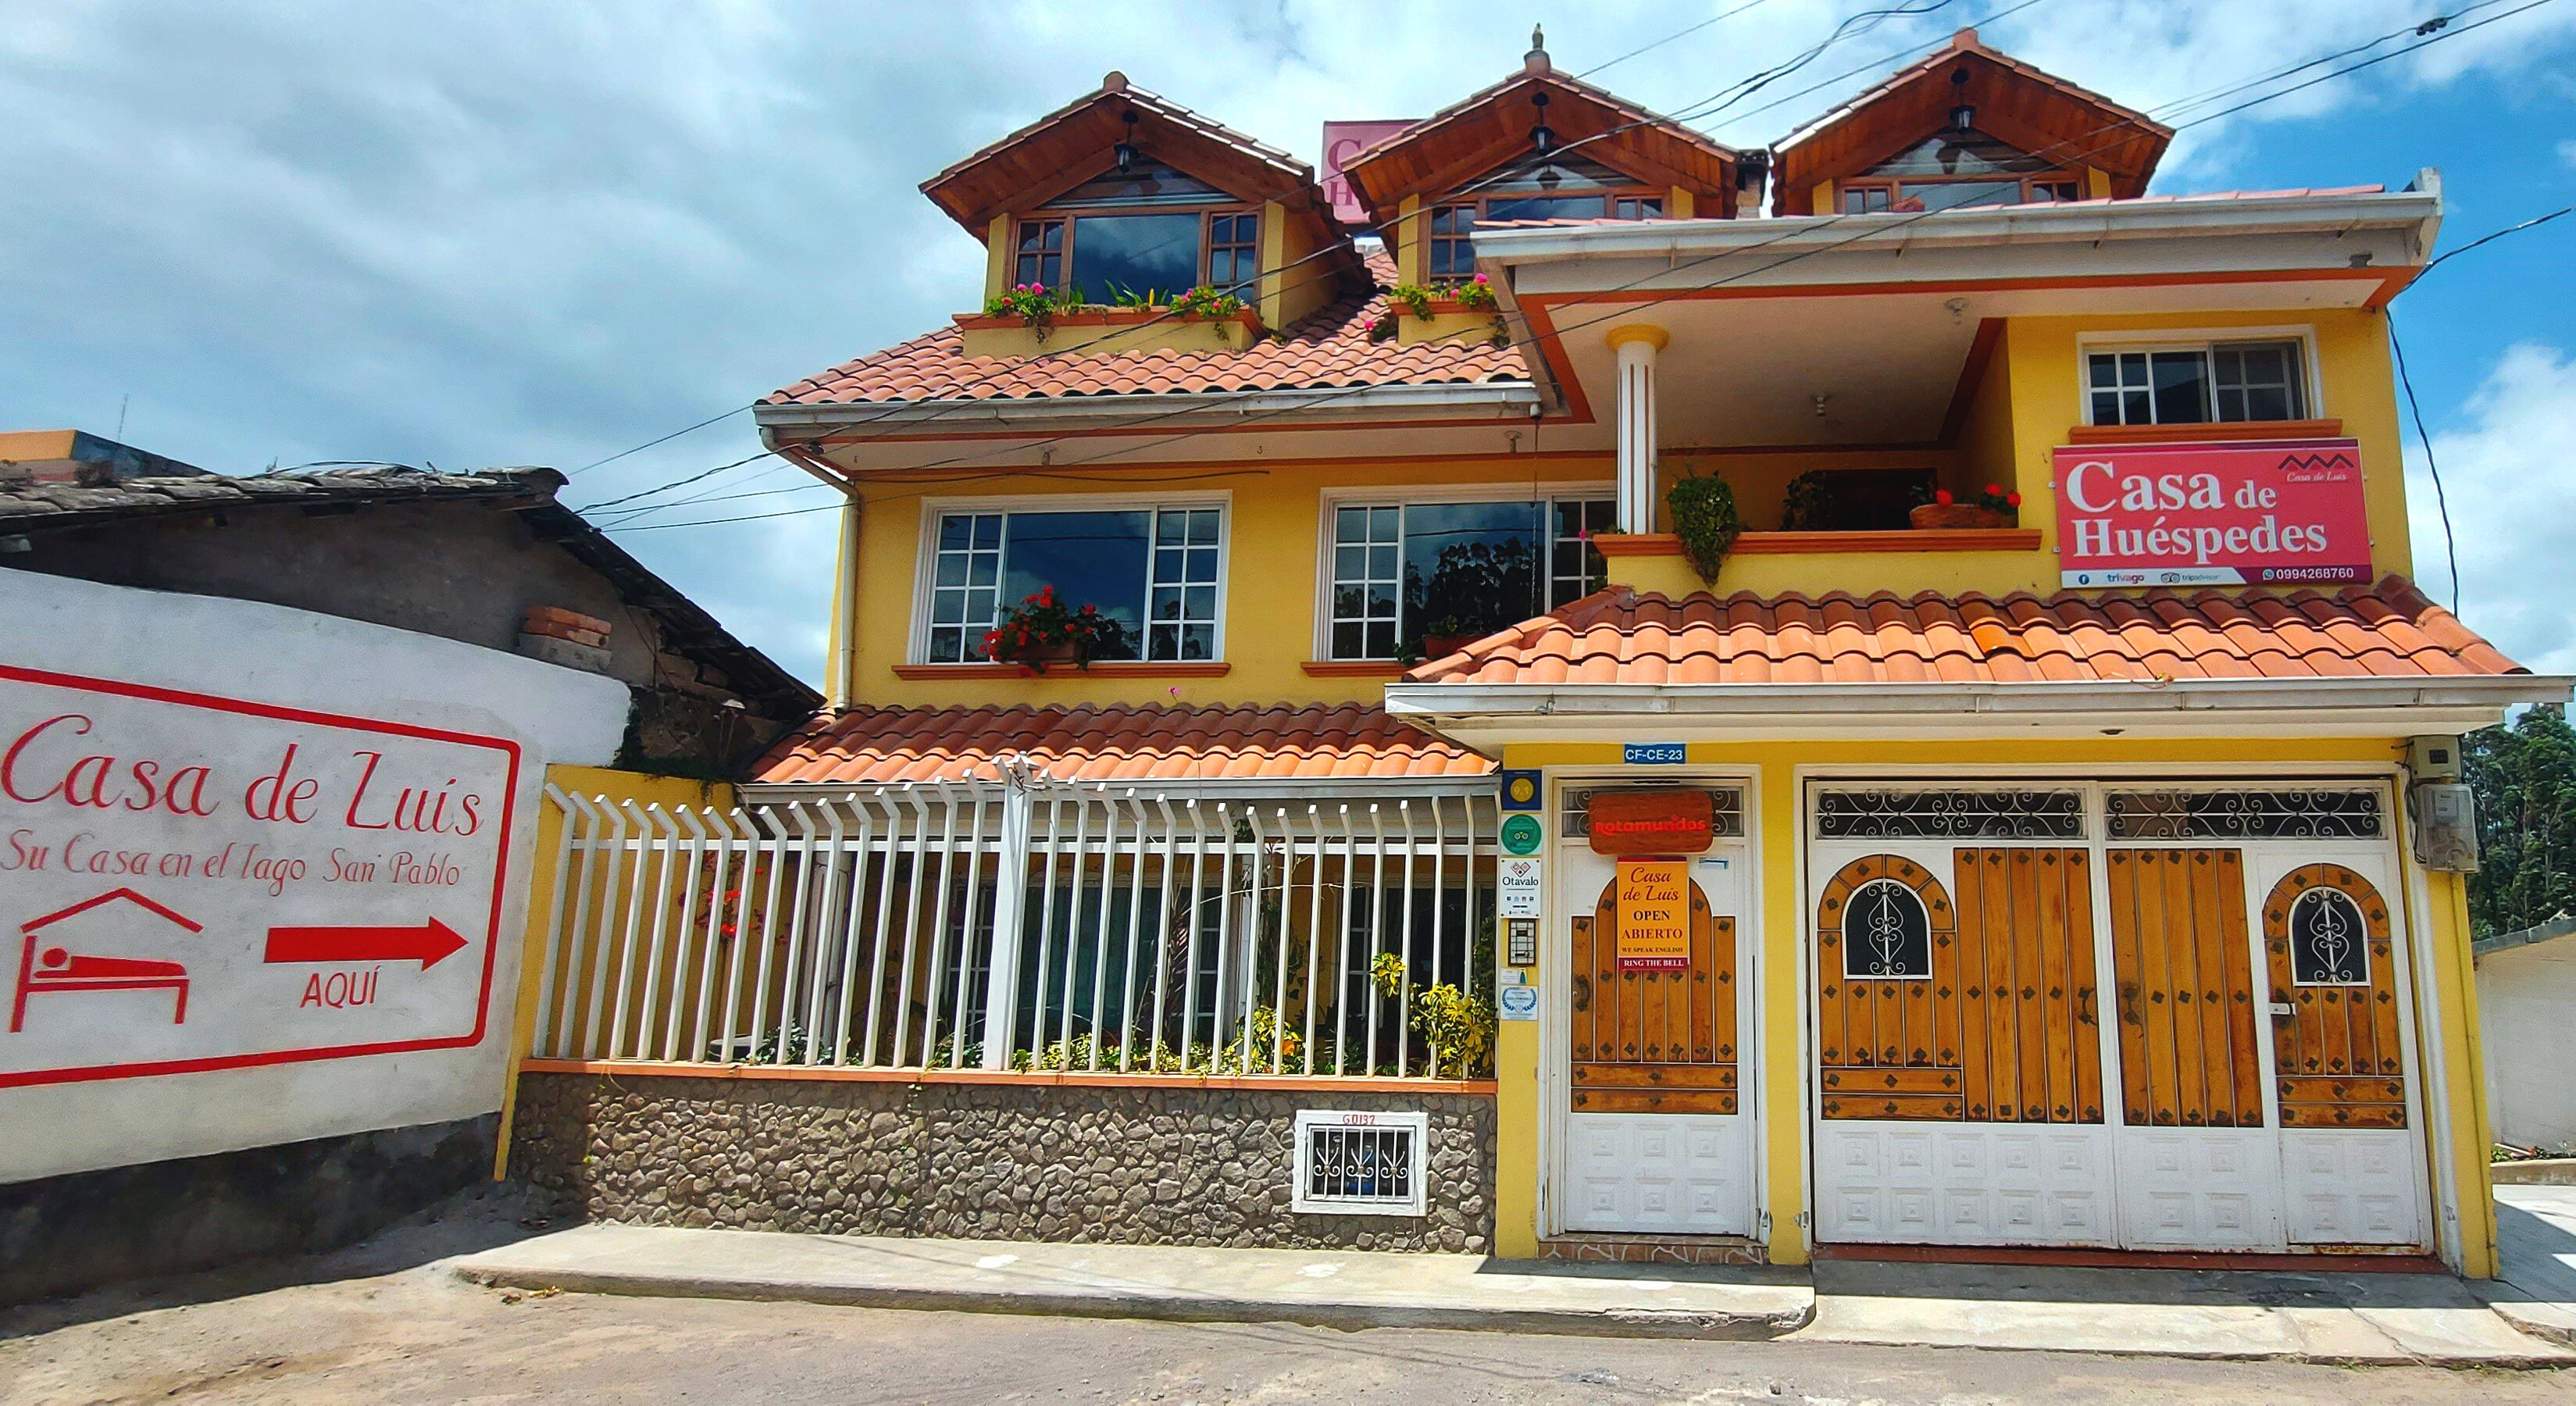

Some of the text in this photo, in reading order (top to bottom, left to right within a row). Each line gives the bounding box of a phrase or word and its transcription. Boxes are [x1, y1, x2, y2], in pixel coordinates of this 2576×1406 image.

[2286, 472, 2310, 482] Casa
[2314, 472, 2324, 481] de
[2066, 460, 2278, 512] Casa de
[2071, 514, 2328, 565] Huéspedes
[2107, 573, 2145, 584] trivago
[2276, 567, 2354, 580] 0994268760
[1625, 749, 1682, 760] CF-CE-23
[2, 714, 220, 817] Casa
[244, 743, 318, 824] de
[2, 828, 460, 896] Su Casa en el lago San Pablo
[1502, 876, 1539, 886] Otavalo
[1631, 867, 1672, 883] Casa
[1623, 886, 1641, 901] de
[1633, 910, 1670, 921] OPEN
[1622, 928, 1682, 939] ABIERTO
[300, 965, 380, 1008] AQUÍ
